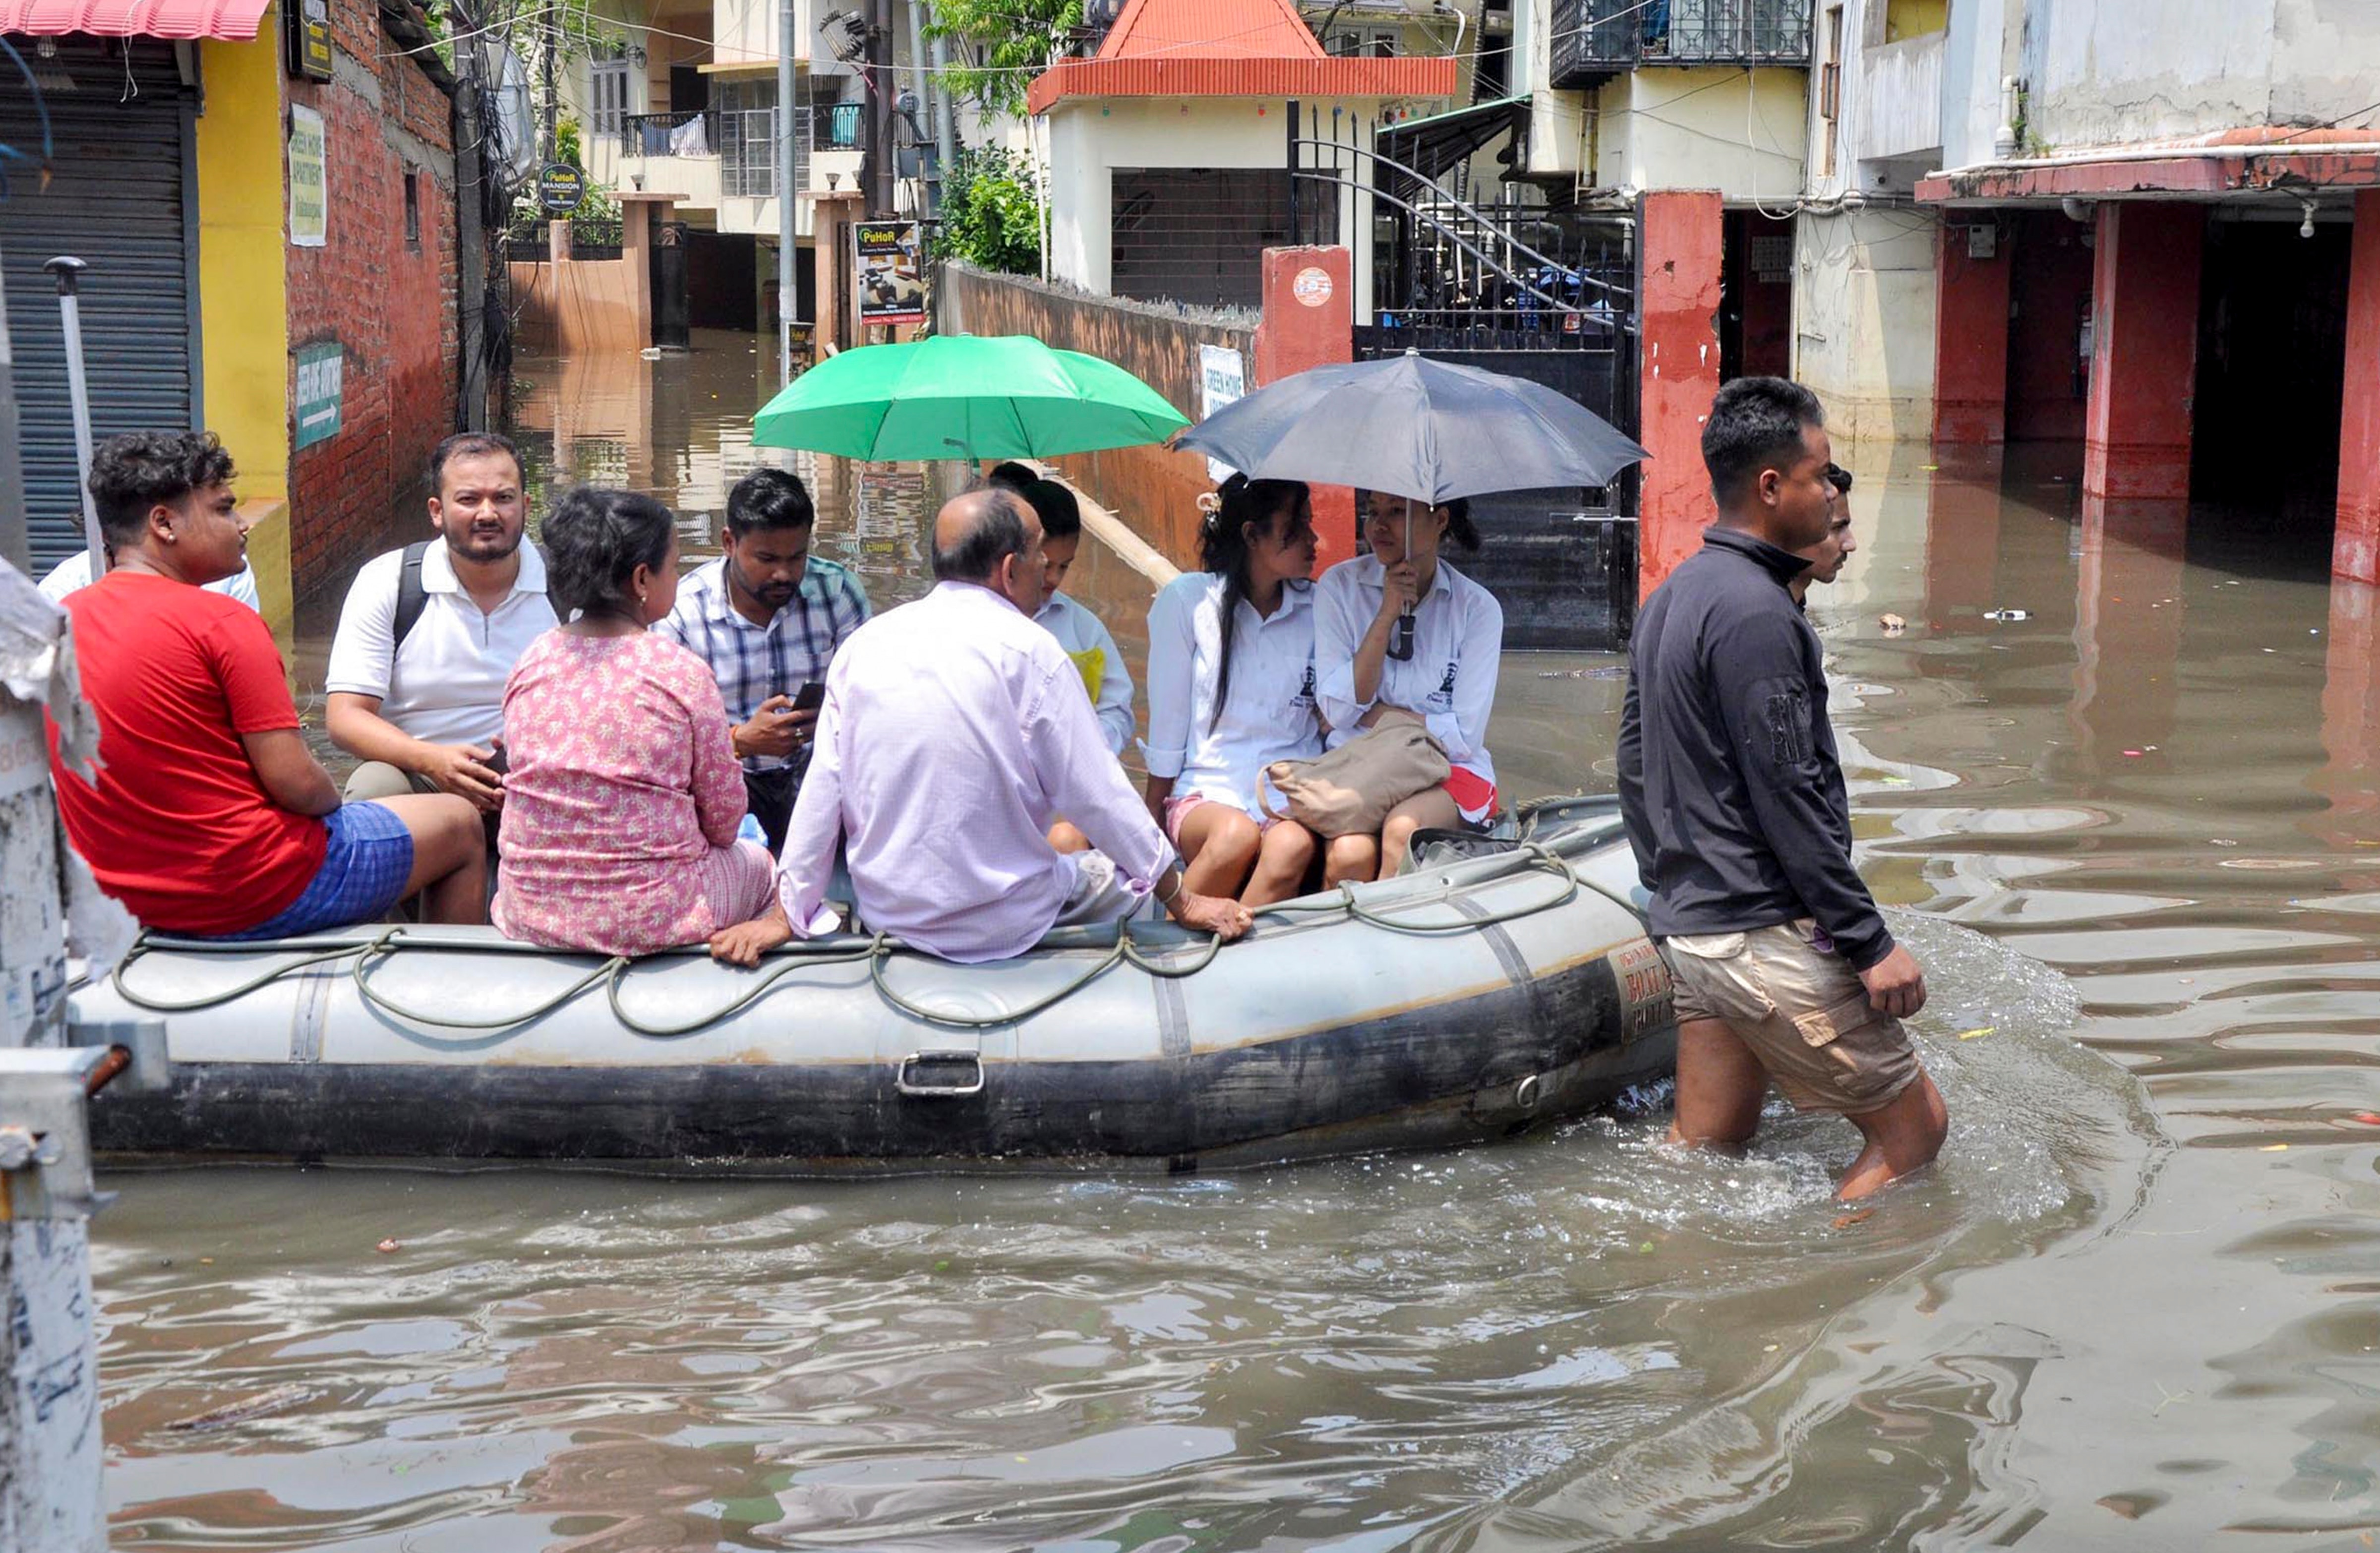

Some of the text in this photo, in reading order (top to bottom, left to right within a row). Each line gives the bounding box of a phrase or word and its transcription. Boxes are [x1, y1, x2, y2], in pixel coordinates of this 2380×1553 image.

[550, 174, 575, 182] PuHoR
[864, 232, 894, 243] PuHoR
[1206, 368, 1223, 394] GREEN
